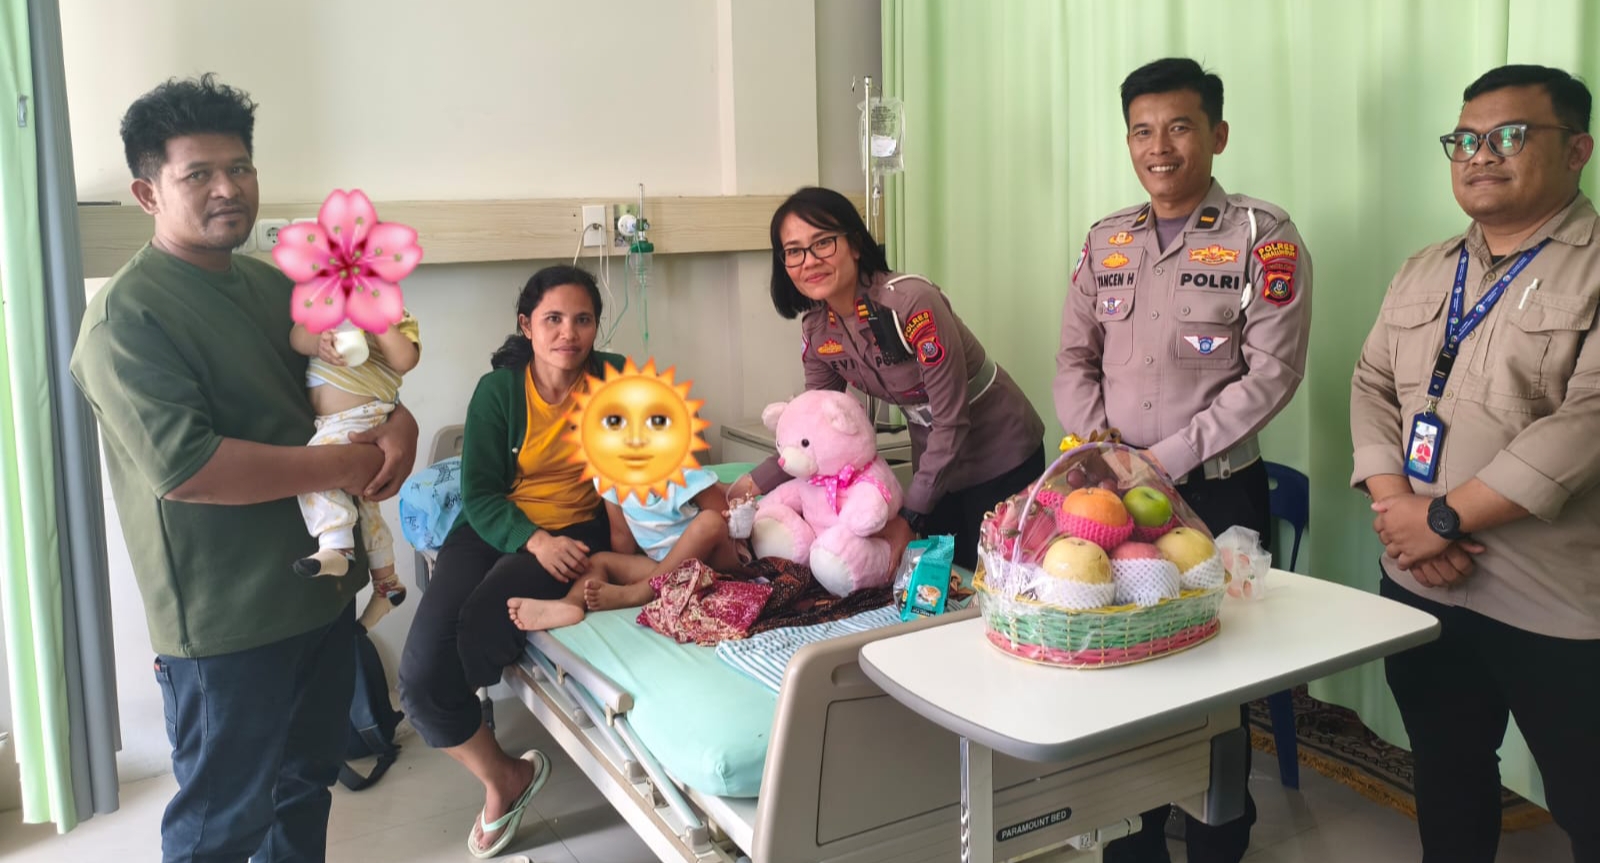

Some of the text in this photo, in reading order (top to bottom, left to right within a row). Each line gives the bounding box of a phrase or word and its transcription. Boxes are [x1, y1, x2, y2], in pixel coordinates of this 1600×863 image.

[1258, 242, 1295, 258] POLRES
[1127, 272, 1135, 286] H
[1180, 272, 1240, 290] POLRI
[1001, 810, 1067, 840] PARAMOUNT BED
